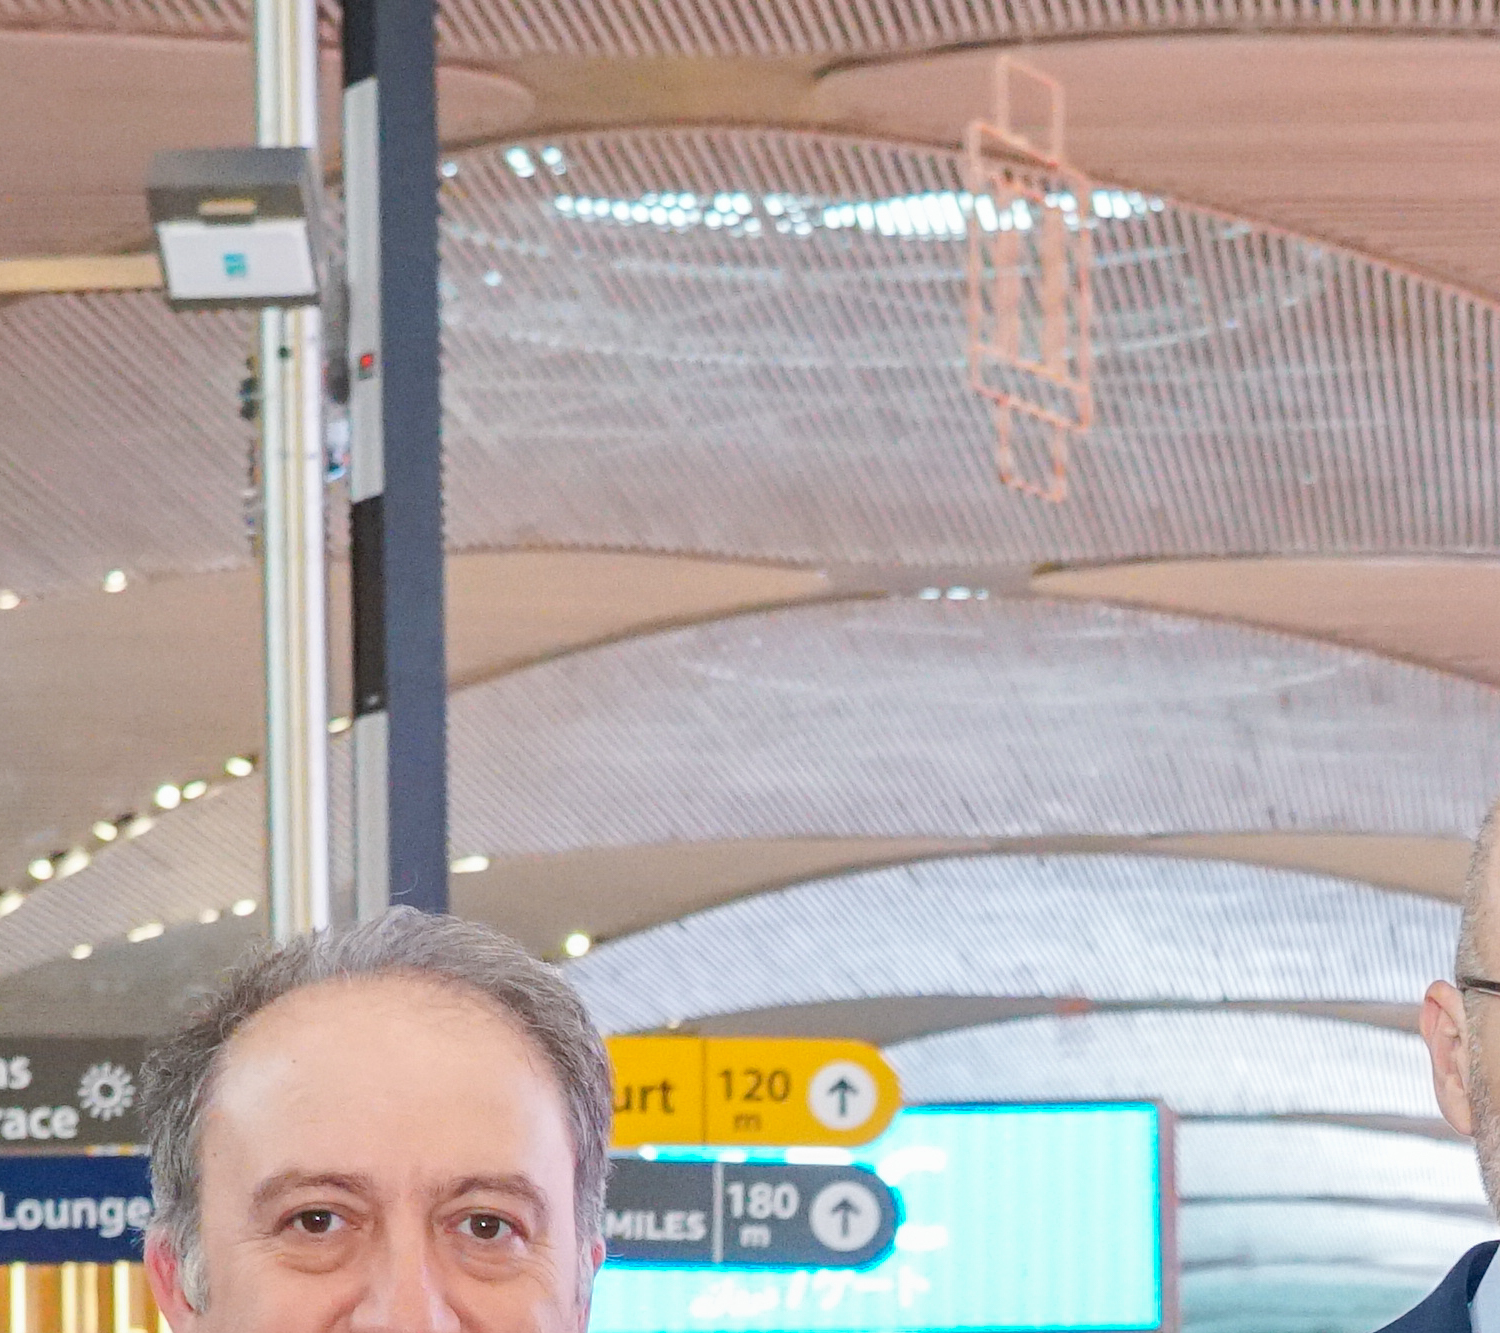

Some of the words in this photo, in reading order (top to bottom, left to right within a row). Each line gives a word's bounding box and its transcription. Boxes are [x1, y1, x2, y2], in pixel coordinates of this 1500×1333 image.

[719, 1067, 791, 1102] 120
[734, 1113, 762, 1132] m
[727, 1182, 799, 1220] 180
[739, 1224, 771, 1248] m
